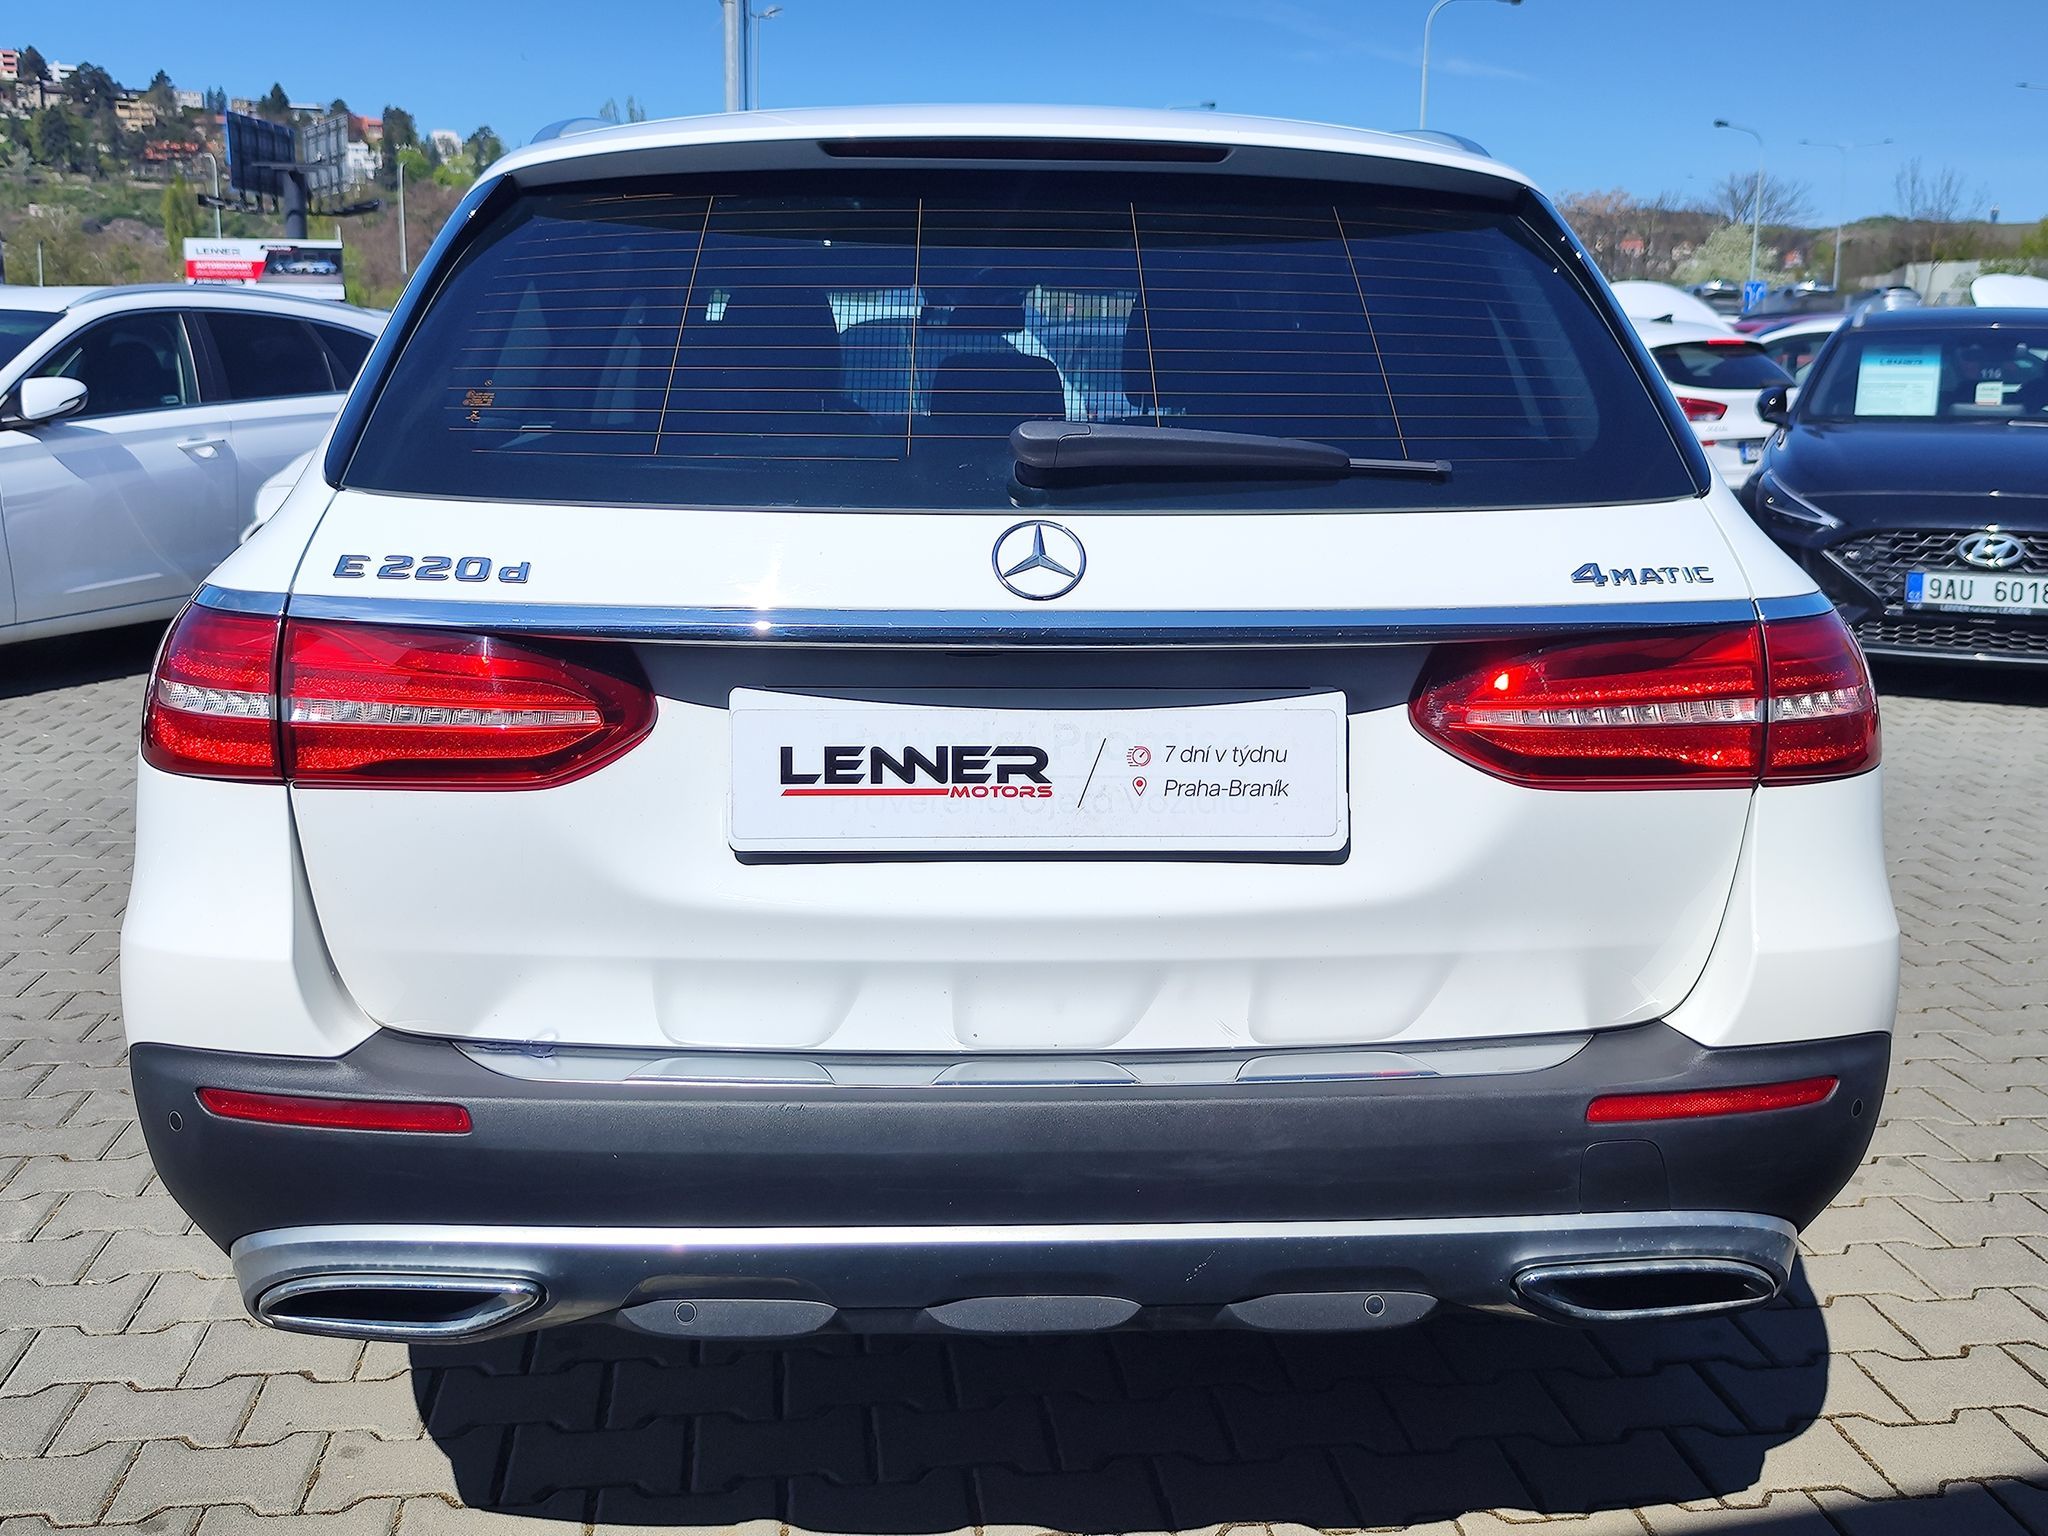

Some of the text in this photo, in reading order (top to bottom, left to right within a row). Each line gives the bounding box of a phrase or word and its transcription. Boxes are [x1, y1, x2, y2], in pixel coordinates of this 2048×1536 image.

[333, 555, 531, 584] E 220 d
[1570, 562, 1714, 587] 4MATIC
[1928, 578, 1974, 601] 9AU
[780, 746, 1053, 785] LENNER
[1165, 744, 1288, 767] 7 dní v týdnu
[949, 785, 1053, 799] MOTORS
[1163, 779, 1290, 797] Praha-Braník
